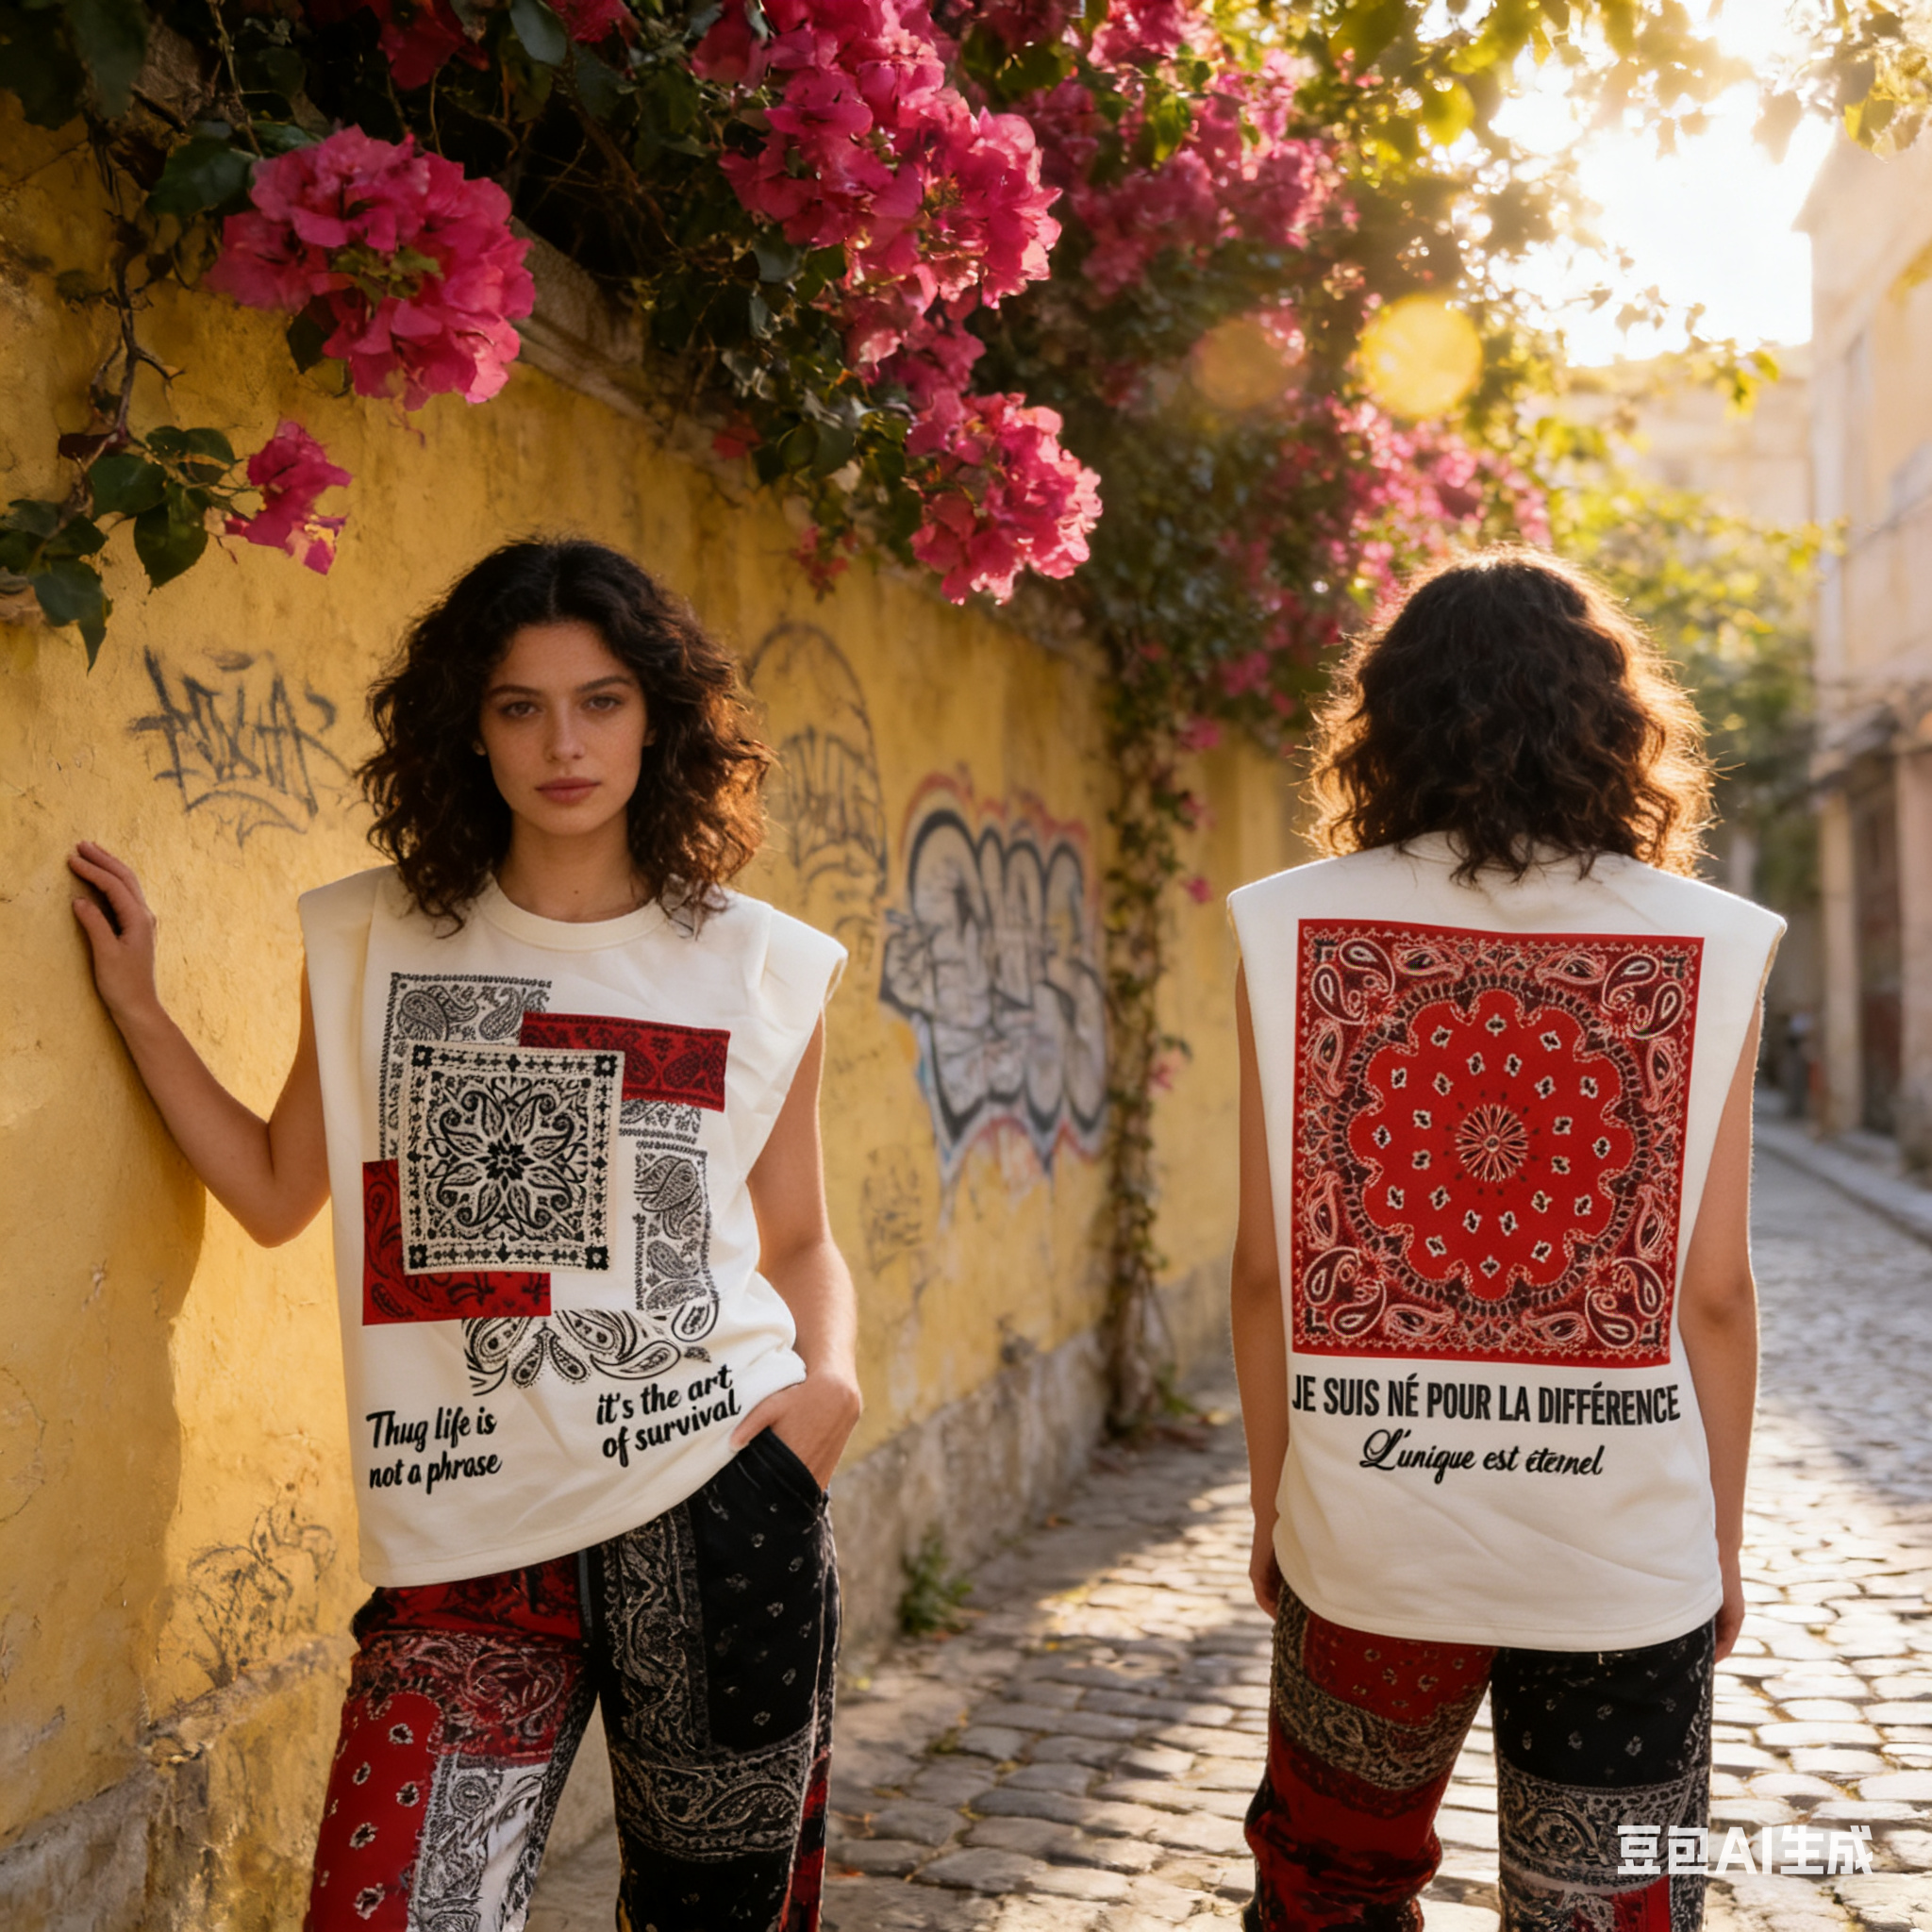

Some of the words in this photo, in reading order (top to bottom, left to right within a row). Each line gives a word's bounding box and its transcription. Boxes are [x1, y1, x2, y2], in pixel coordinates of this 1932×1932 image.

[596, 1392, 634, 1425] it's
[641, 1383, 681, 1414] the
[687, 1363, 733, 1401] art
[1291, 1374, 1317, 1413] JE
[1324, 1377, 1380, 1416] SUIS
[1388, 1373, 1419, 1418] NÉ
[1426, 1382, 1491, 1420] POUR
[1499, 1385, 1531, 1423] LA
[1539, 1381, 1681, 1425] DIFFÉRENCE
[366, 1410, 429, 1453] Thug
[435, 1407, 472, 1447] life
[476, 1407, 498, 1436] is
[602, 1425, 633, 1468] of
[636, 1389, 741, 1451] survival
[369, 1461, 404, 1490] not
[408, 1466, 422, 1485] a
[425, 1451, 503, 1495] phrase
[1482, 1445, 1520, 1472] est
